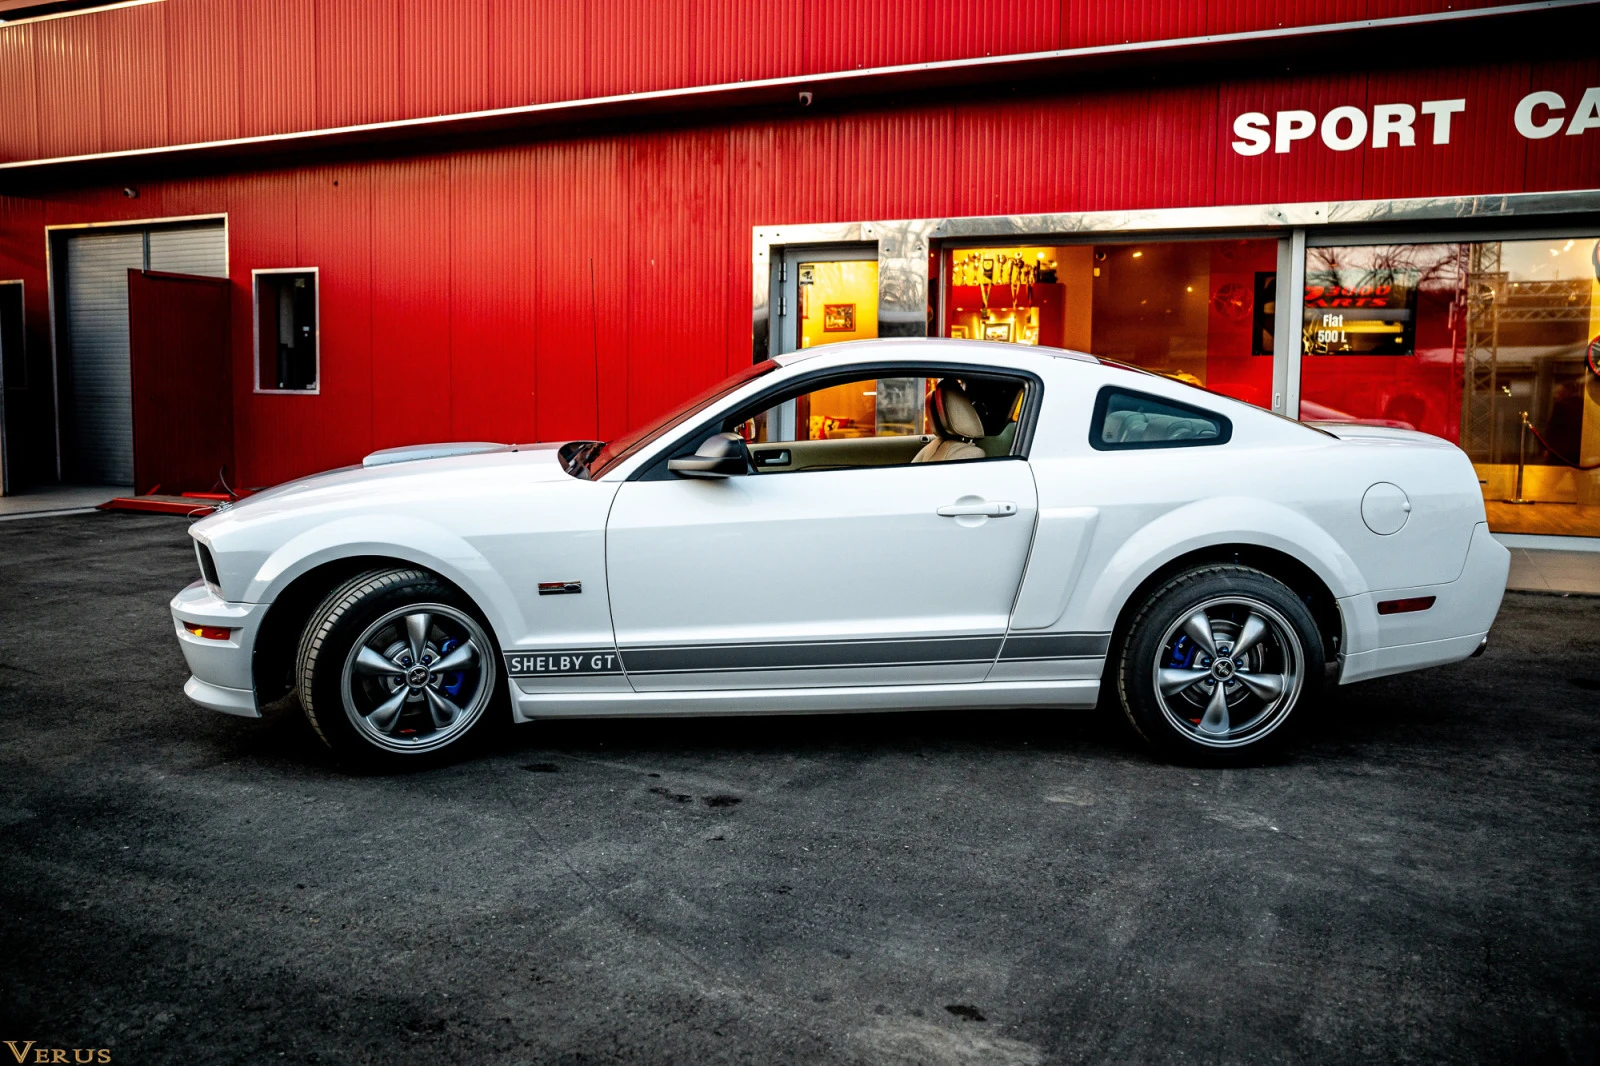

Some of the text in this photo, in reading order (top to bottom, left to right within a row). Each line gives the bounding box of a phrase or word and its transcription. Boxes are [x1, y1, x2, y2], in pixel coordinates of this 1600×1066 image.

[1231, 87, 1600, 157] SPORT CA
[1322, 313, 1344, 328] Fiat
[1317, 330, 1347, 343] 500 L
[511, 655, 615, 672] SHELBY GT
